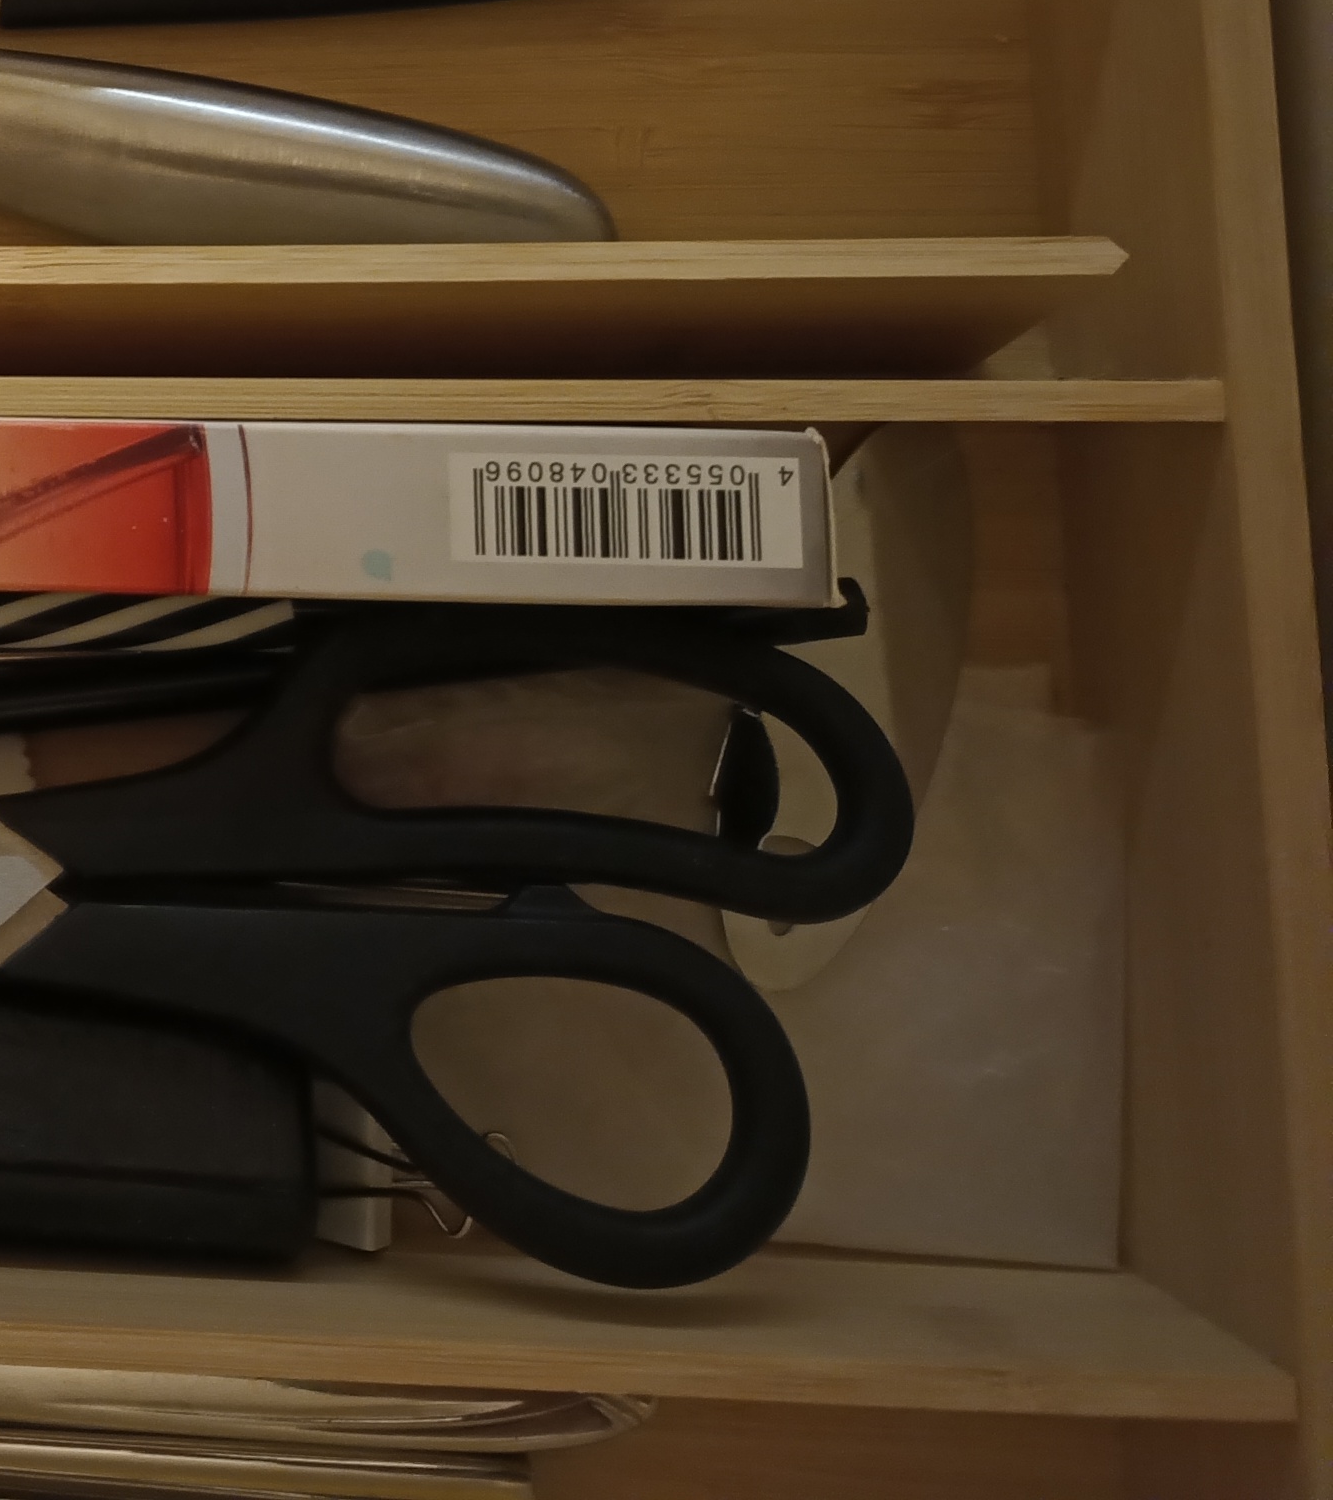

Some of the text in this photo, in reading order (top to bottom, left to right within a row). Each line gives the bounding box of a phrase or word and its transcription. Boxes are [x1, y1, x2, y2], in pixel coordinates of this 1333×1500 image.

[485, 461, 794, 487] 4 055333 048096
